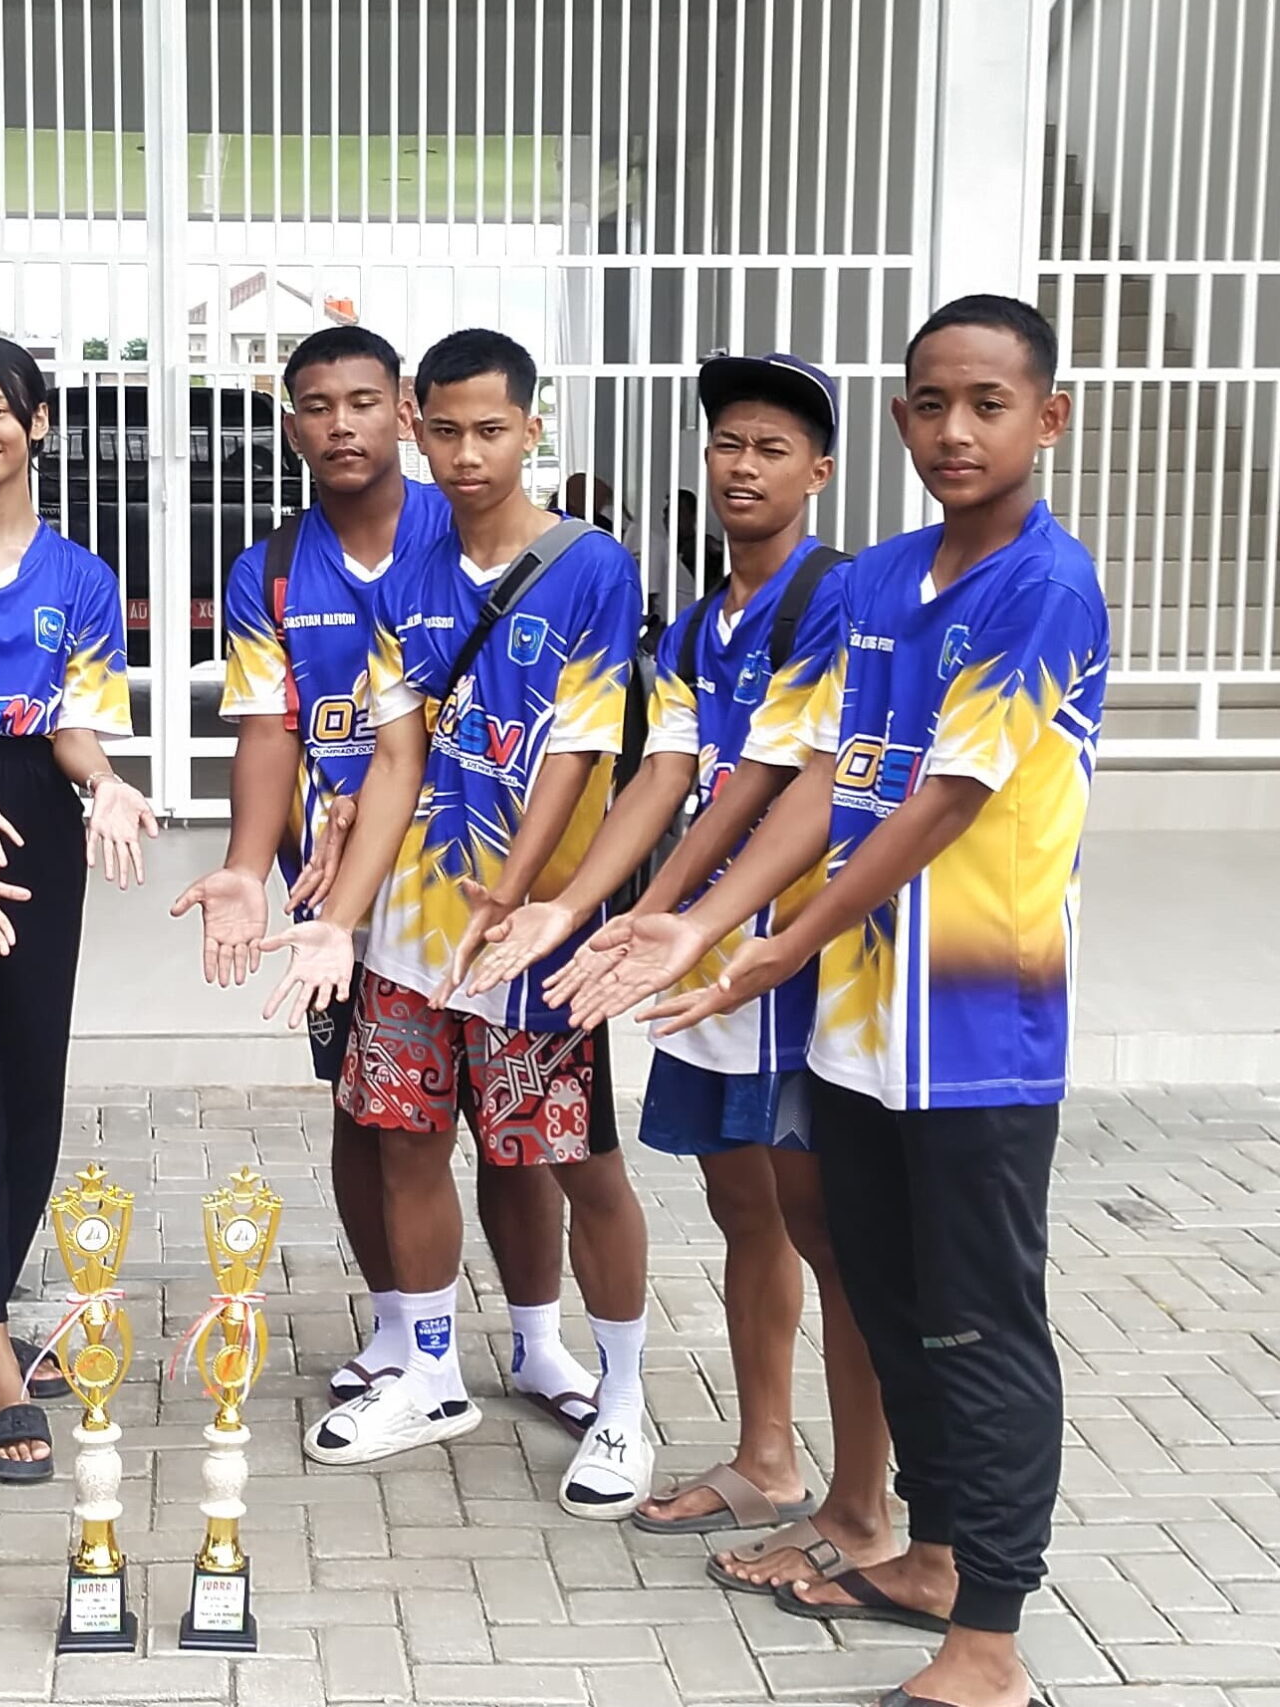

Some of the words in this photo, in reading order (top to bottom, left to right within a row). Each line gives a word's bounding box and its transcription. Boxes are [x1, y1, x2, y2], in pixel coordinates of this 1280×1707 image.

[130, 602, 148, 619] AD
[430, 1335, 441, 1345] 2
[77, 1583, 108, 1594] JUARA
[202, 1580, 232, 1591] JUARA
